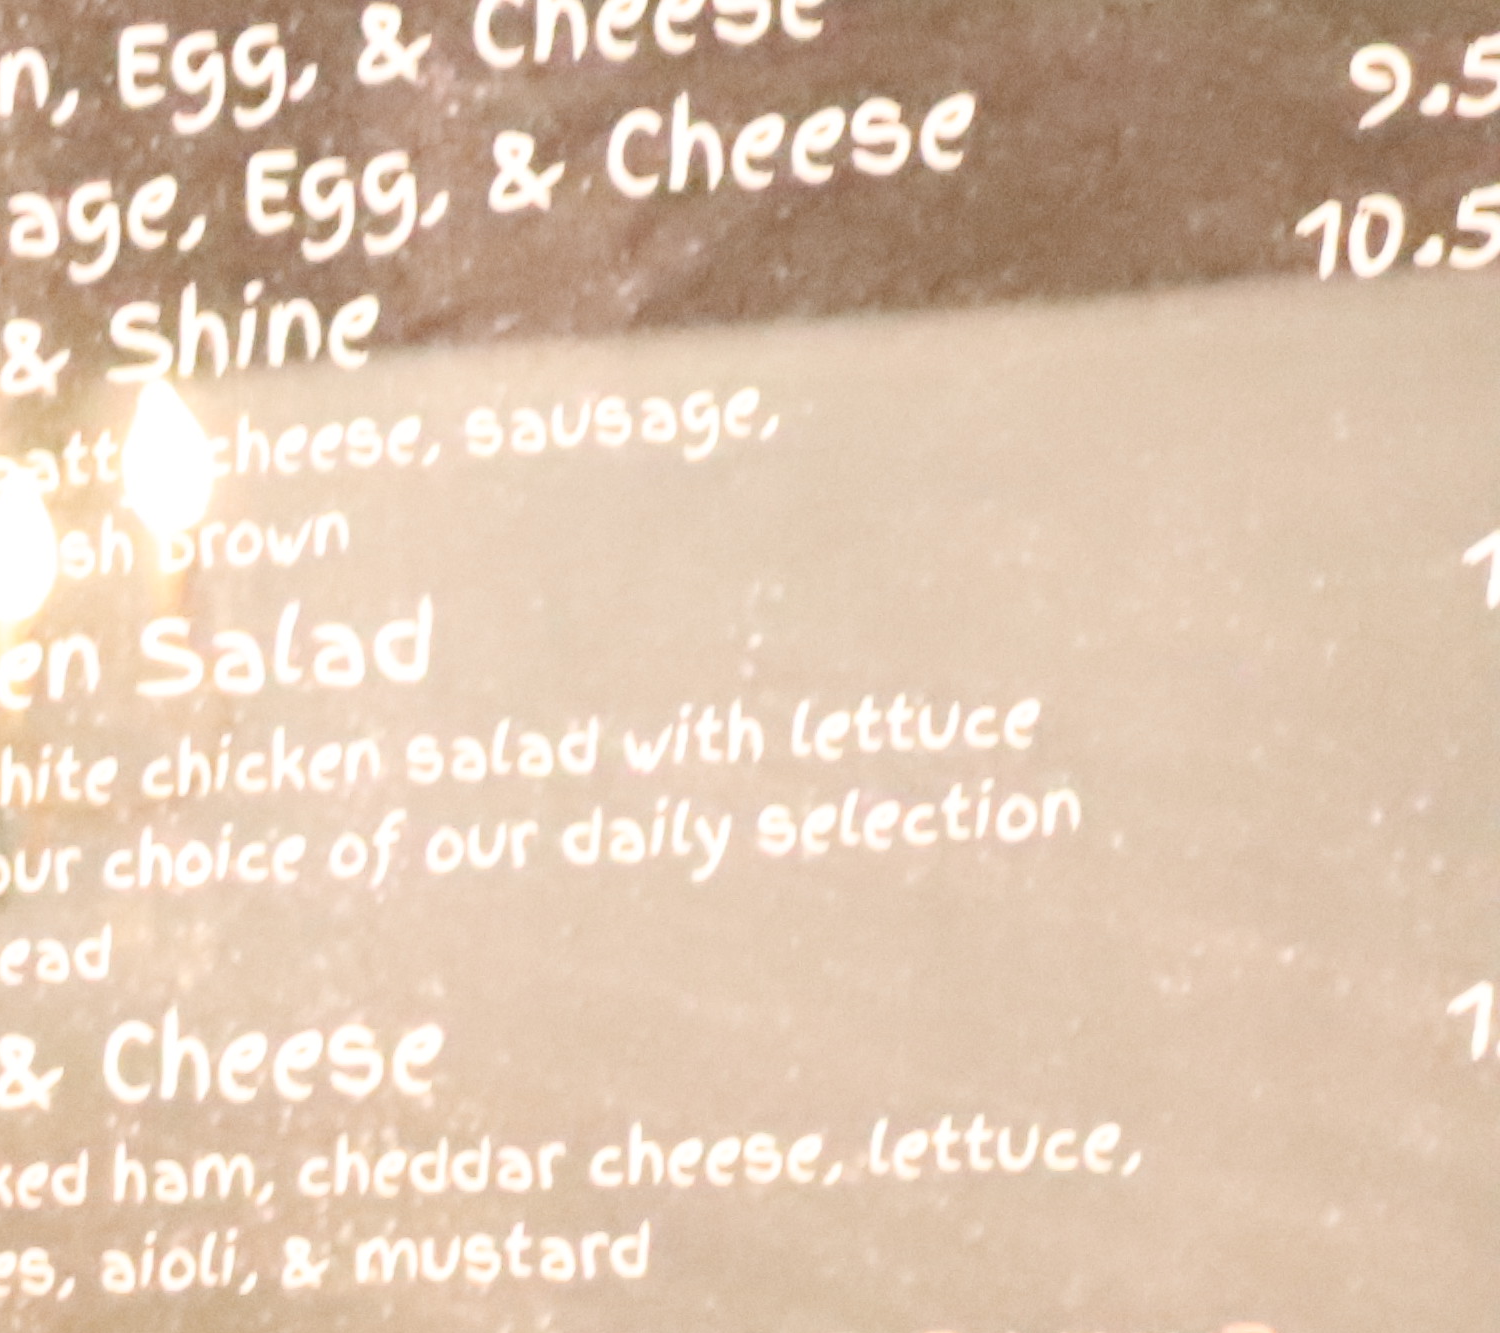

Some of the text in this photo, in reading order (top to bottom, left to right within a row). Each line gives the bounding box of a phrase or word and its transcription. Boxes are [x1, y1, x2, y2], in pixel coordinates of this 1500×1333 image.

[117, 22, 318, 135] Egg,
[357, 2, 432, 85] &
[245, 148, 450, 262] Egg,
[488, 129, 566, 213] &
[606, 90, 977, 199] Cheese
[0, 317, 71, 397] &
[106, 280, 380, 381] Shine
[197, 411, 442, 478] cheese,
[464, 386, 781, 463] sausage,
[136, 593, 434, 699] Salad
[140, 725, 381, 799] chicken
[405, 715, 600, 785] salad
[622, 700, 764, 774] with
[790, 692, 1042, 761] lettuce
[102, 823, 307, 891] choice
[327, 808, 407, 890] of
[424, 818, 539, 875] our
[560, 795, 733, 883] daily
[756, 778, 1083, 859] selection
[101, 1004, 445, 1106] Cheese
[112, 1142, 275, 1208] ham,
[298, 1131, 567, 1199] cheddar
[588, 1120, 845, 1189] cheese,
[868, 1112, 1143, 1183] lettuce,
[101, 1227, 258, 1297] aioli,
[279, 1234, 330, 1291] &
[355, 1218, 651, 1285] mustard
